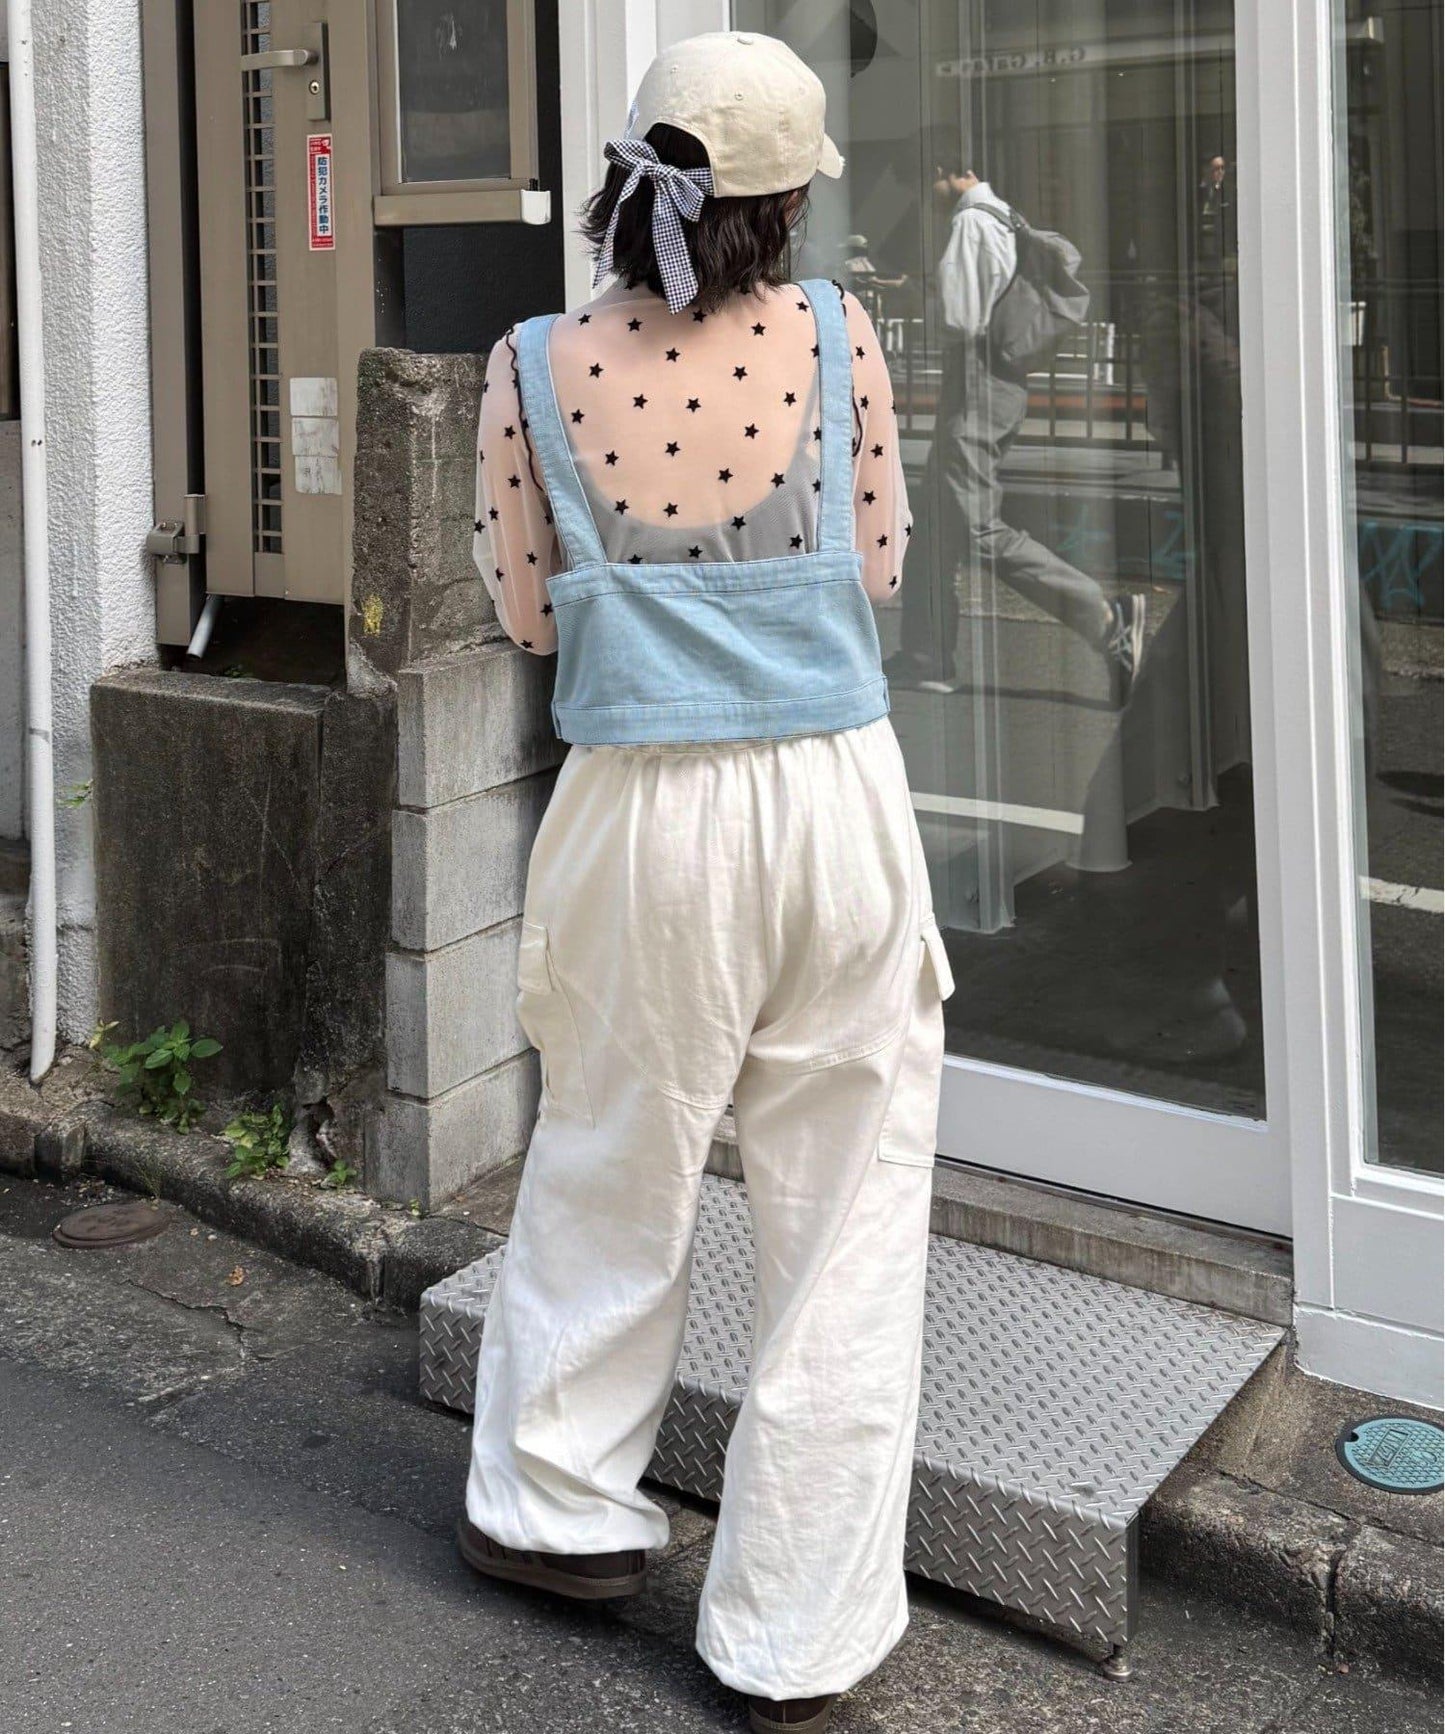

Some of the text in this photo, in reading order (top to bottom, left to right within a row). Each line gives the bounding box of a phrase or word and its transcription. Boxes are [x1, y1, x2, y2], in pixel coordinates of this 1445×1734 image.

[318, 156, 329, 234] 防犯カメラ作動中
